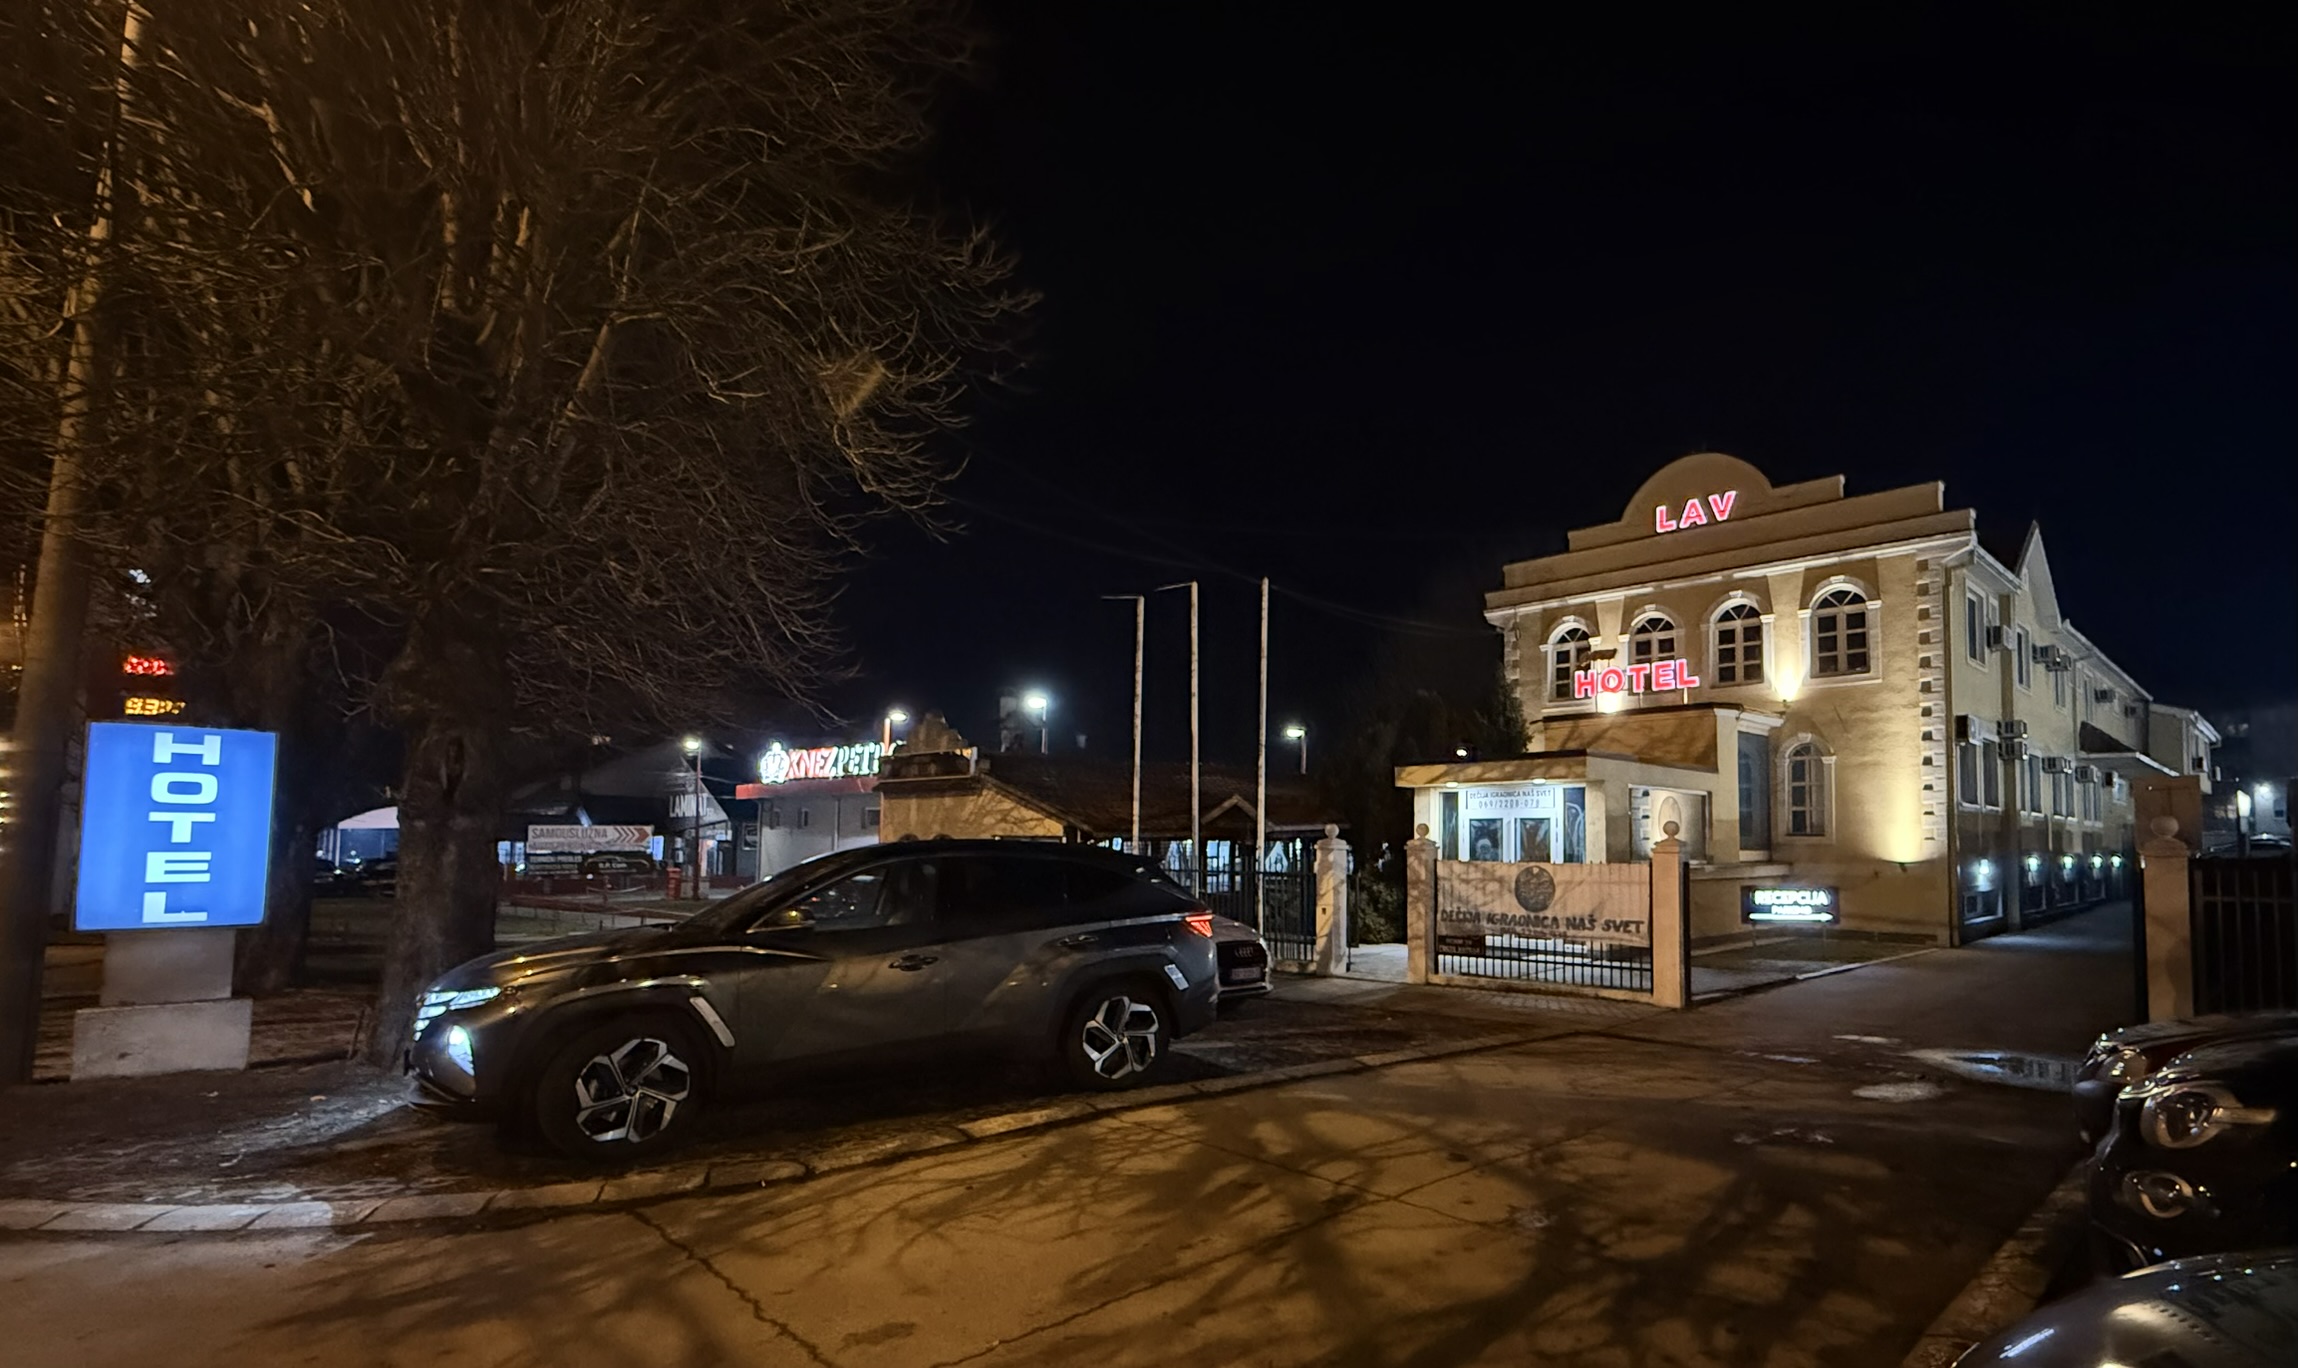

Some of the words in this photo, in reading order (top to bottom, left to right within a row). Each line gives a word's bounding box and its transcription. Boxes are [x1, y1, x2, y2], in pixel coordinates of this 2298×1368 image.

[1655, 490, 1738, 535] LAV
[1574, 658, 1700, 699] HOTEL
[141, 731, 222, 924] HOTEL
[1440, 909, 1481, 925] DEČIJA
[1485, 912, 1560, 931] IGRAONICA
[1565, 914, 1597, 932] NAŠ
[1601, 919, 1645, 935] SVET
